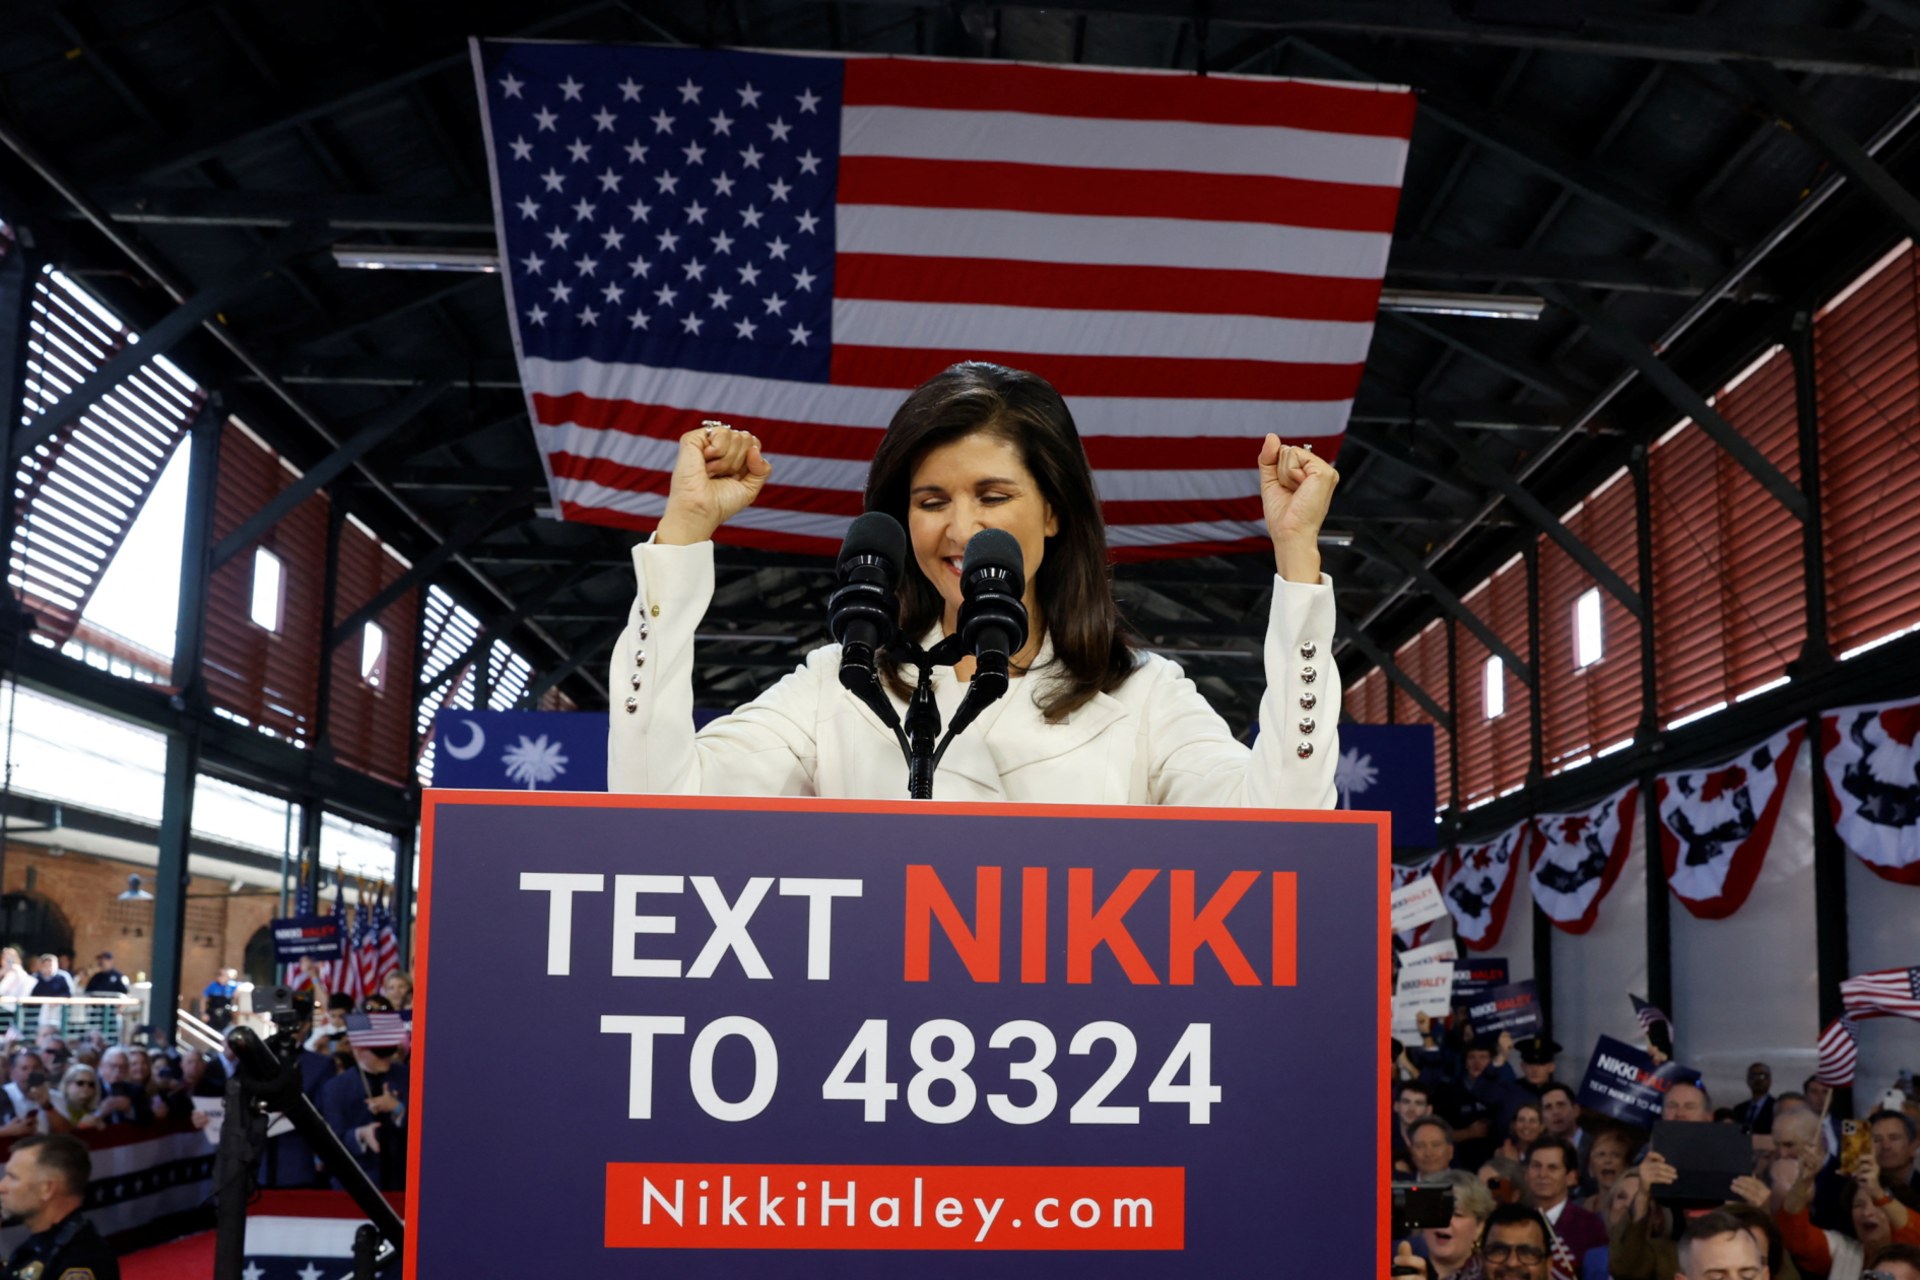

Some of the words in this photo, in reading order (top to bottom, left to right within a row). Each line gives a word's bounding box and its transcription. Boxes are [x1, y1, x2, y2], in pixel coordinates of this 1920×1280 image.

[519, 872, 863, 981] TEXT
[904, 864, 1298, 987] NIKKI
[600, 1014, 779, 1122] TO
[822, 1018, 1222, 1125] 48324
[642, 1175, 1153, 1243] NikkiHaley.com
